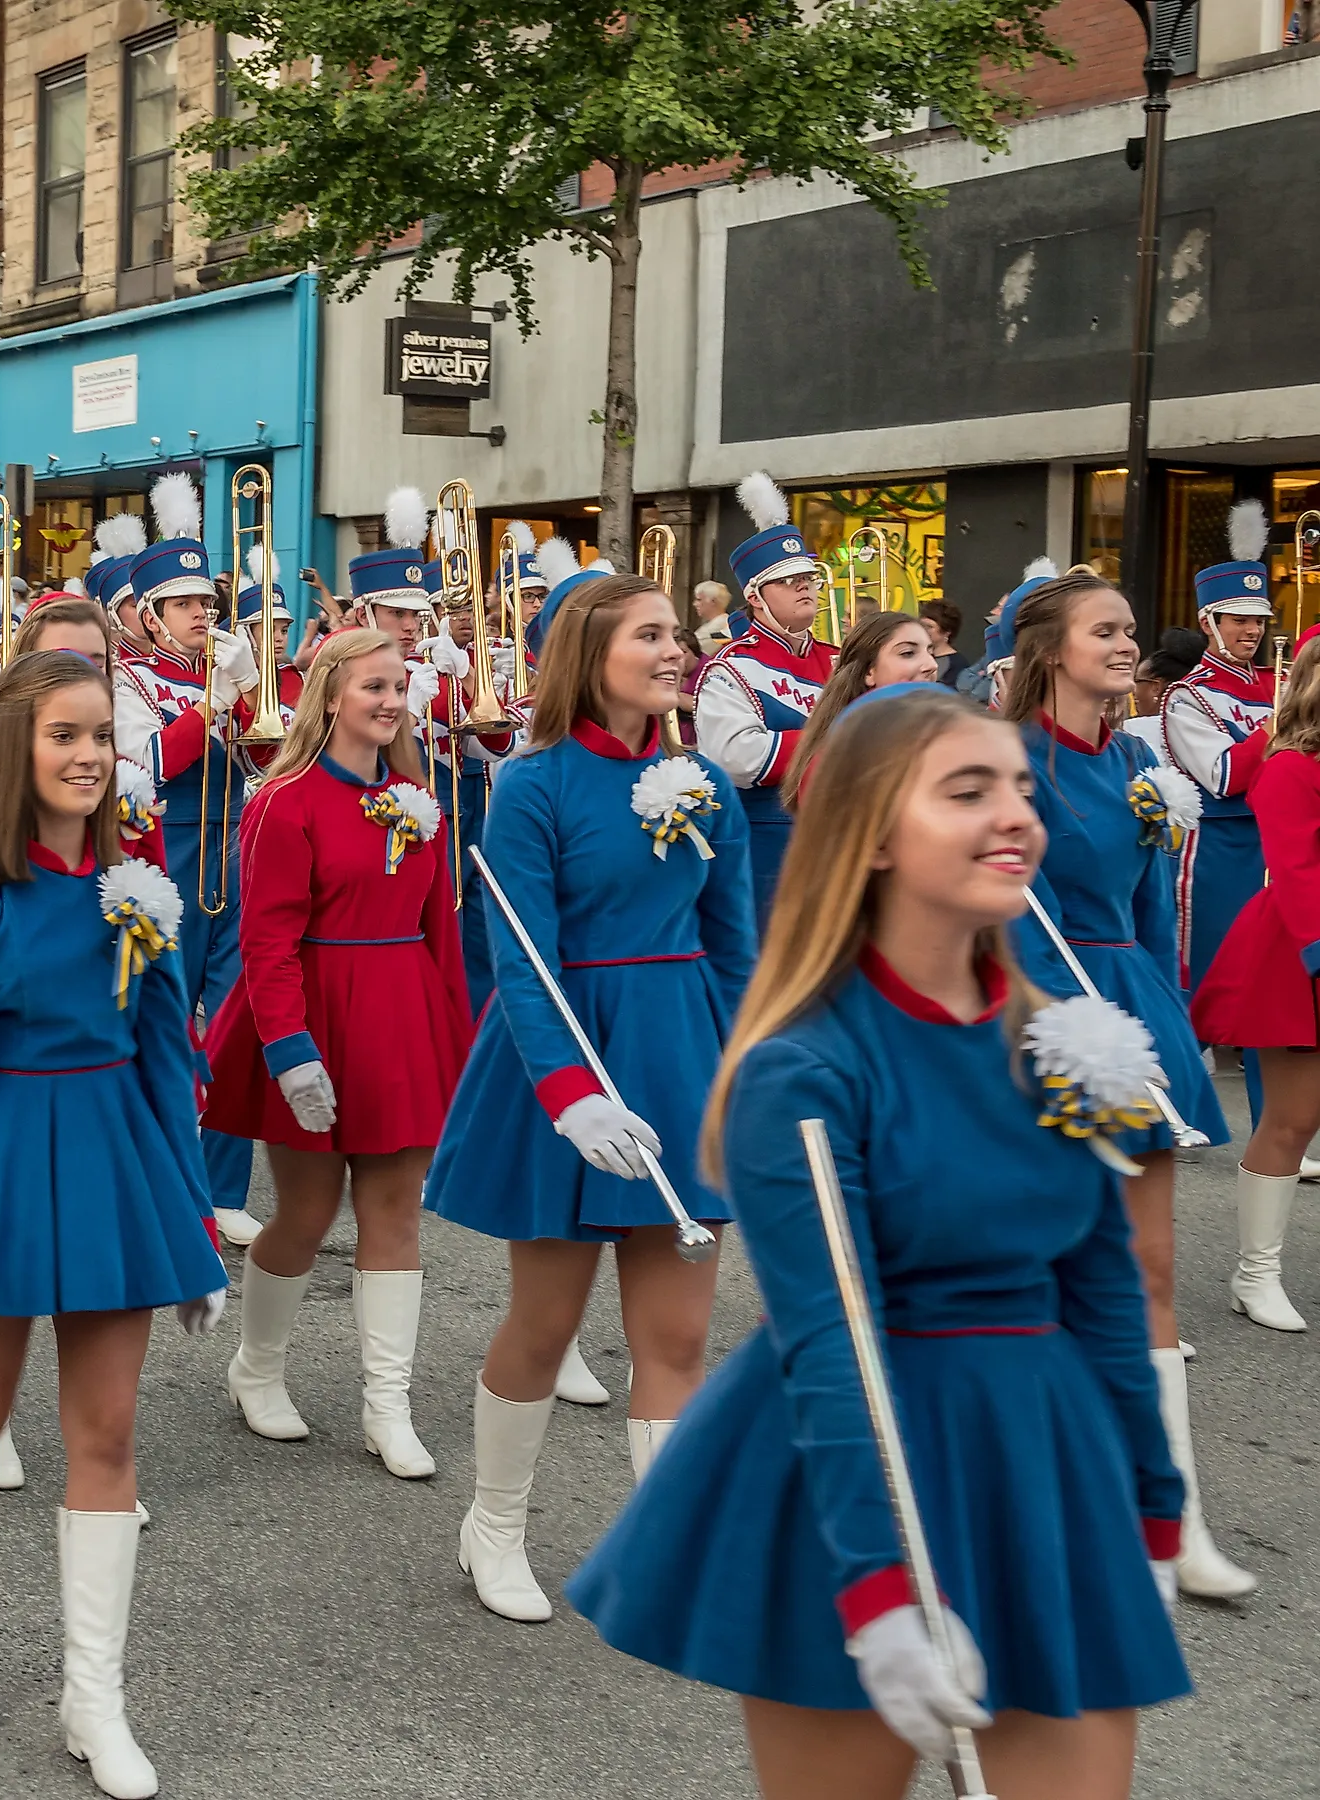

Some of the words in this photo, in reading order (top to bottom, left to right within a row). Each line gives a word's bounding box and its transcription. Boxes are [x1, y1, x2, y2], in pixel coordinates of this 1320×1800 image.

[403, 330, 439, 347] silver
[439, 334, 488, 351] pennies
[400, 347, 490, 386] jewelry
